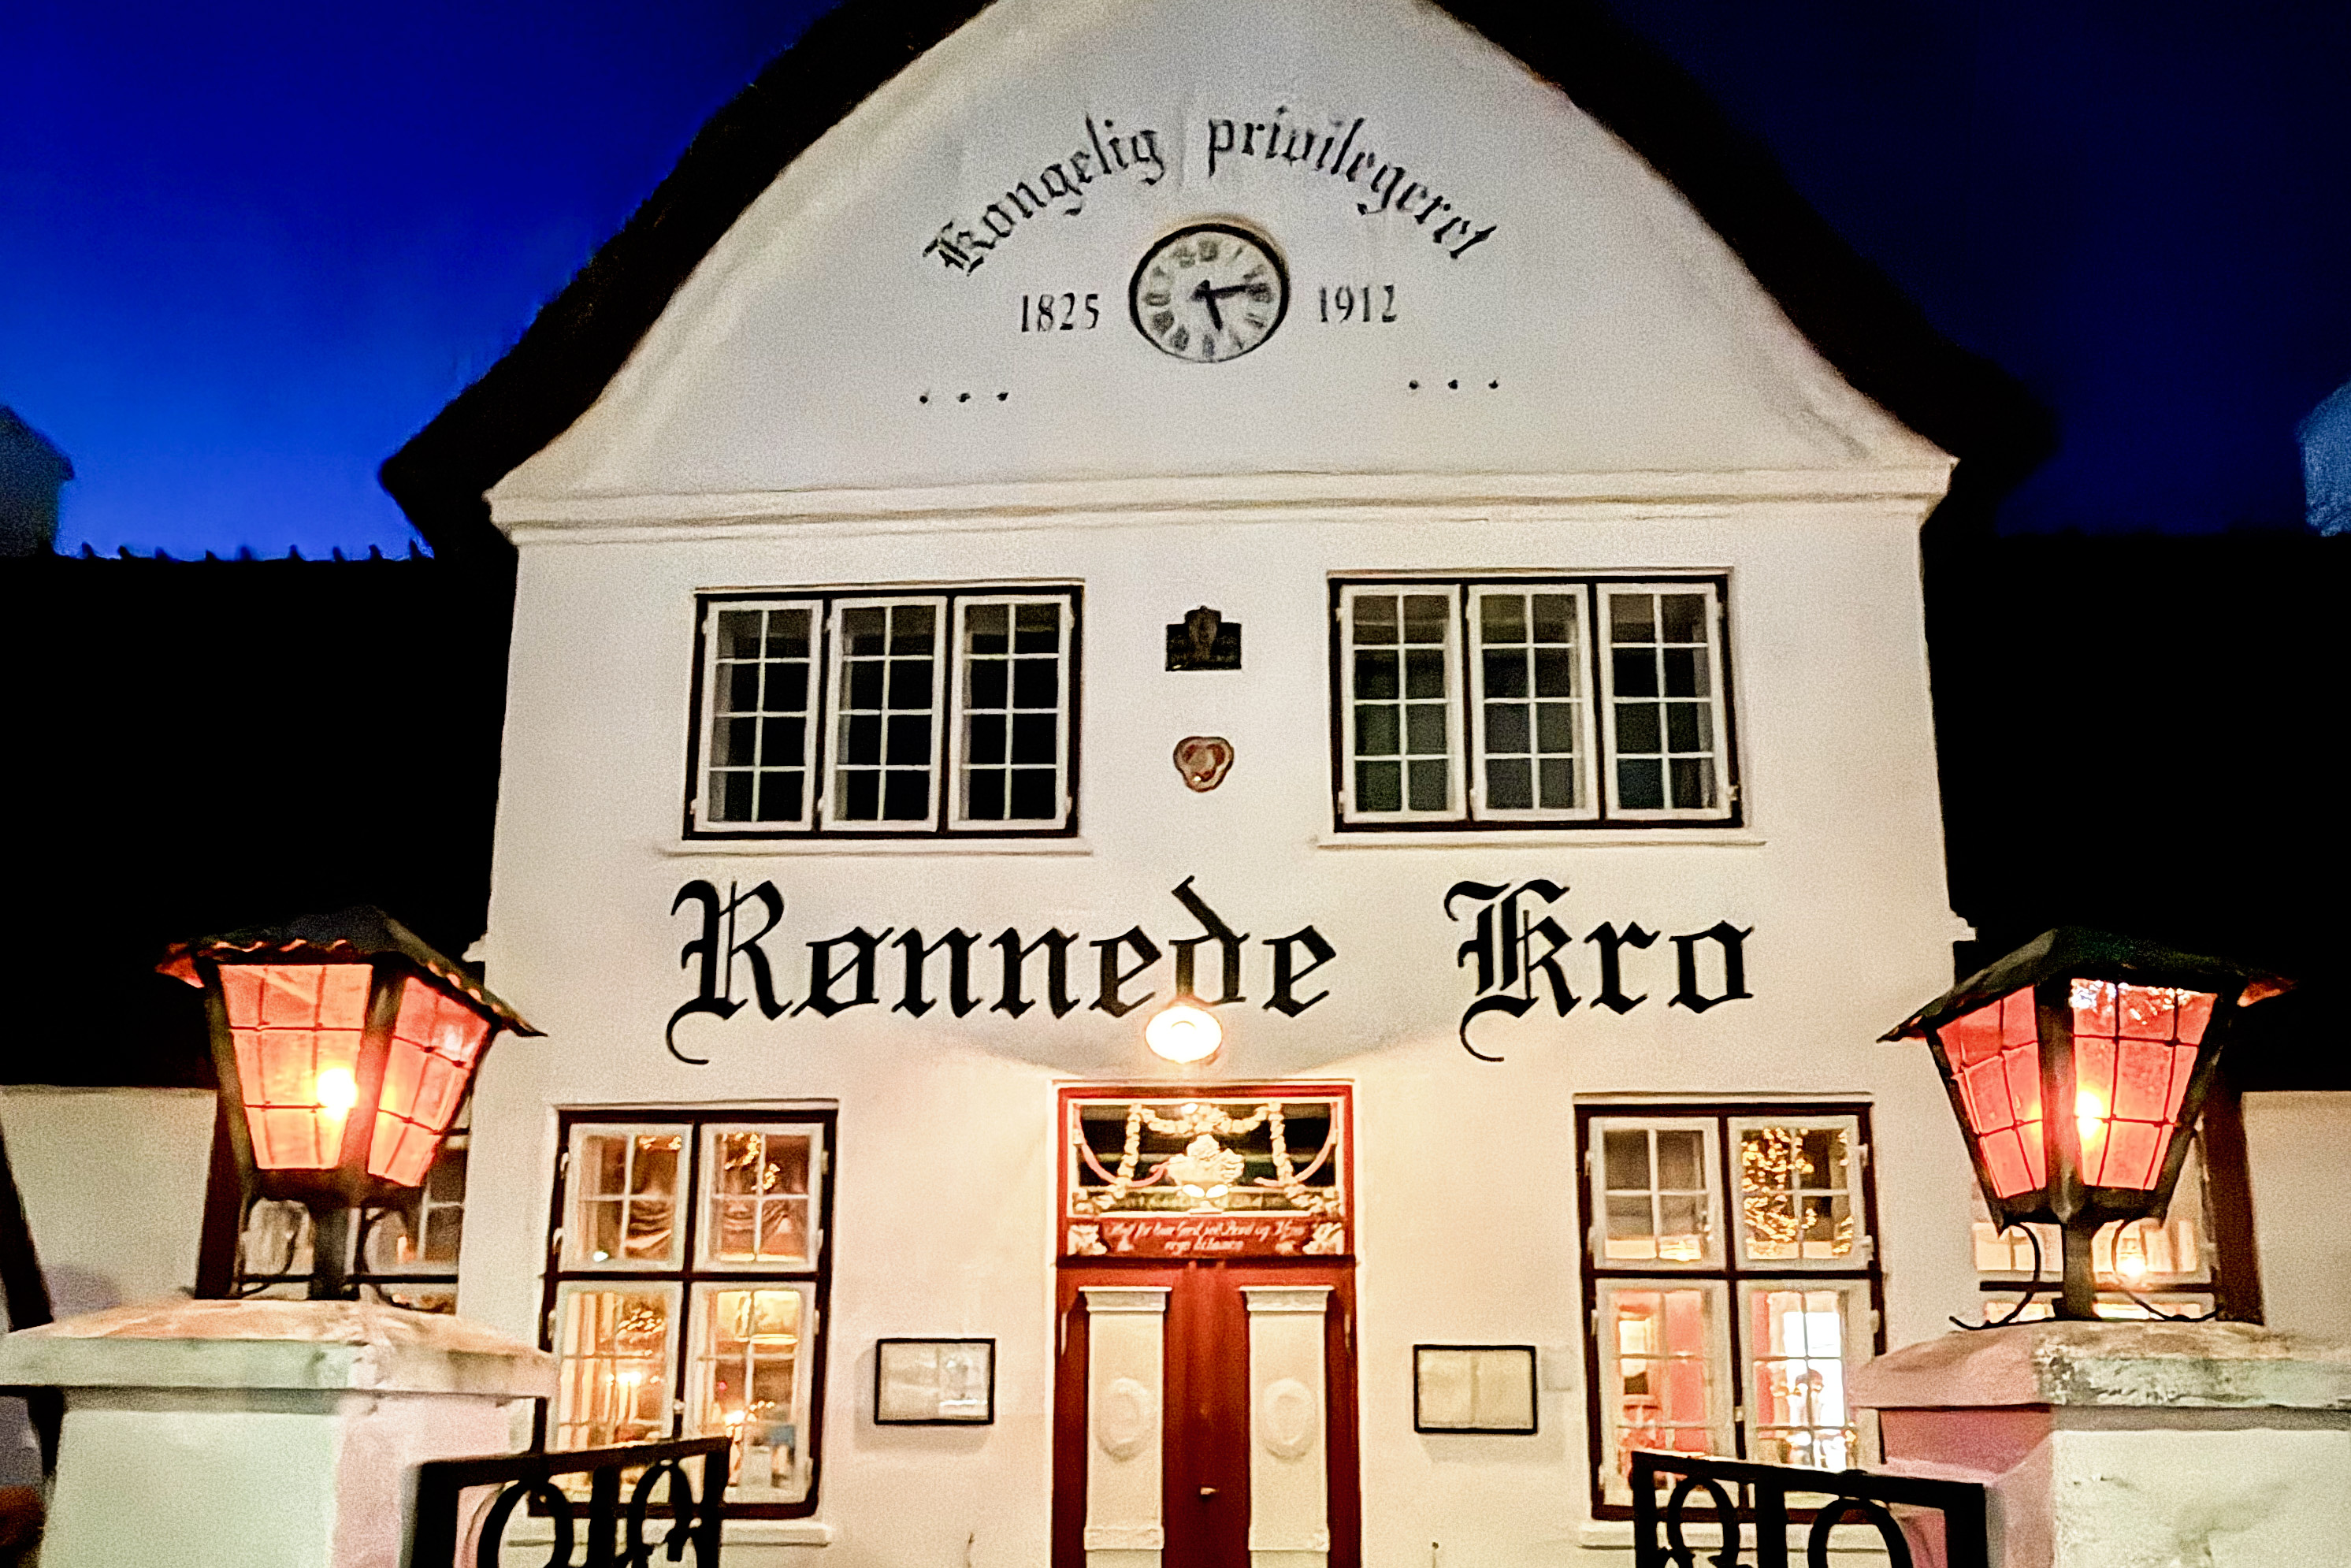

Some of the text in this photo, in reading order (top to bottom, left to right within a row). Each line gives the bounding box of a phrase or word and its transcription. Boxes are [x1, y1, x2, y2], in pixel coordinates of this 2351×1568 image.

[923, 105, 1498, 277] Kongelig privilegeret
[1021, 292, 1099, 332] 1825
[1320, 284, 1397, 323] 1912
[667, 875, 1754, 1065] Rønnede Kro
